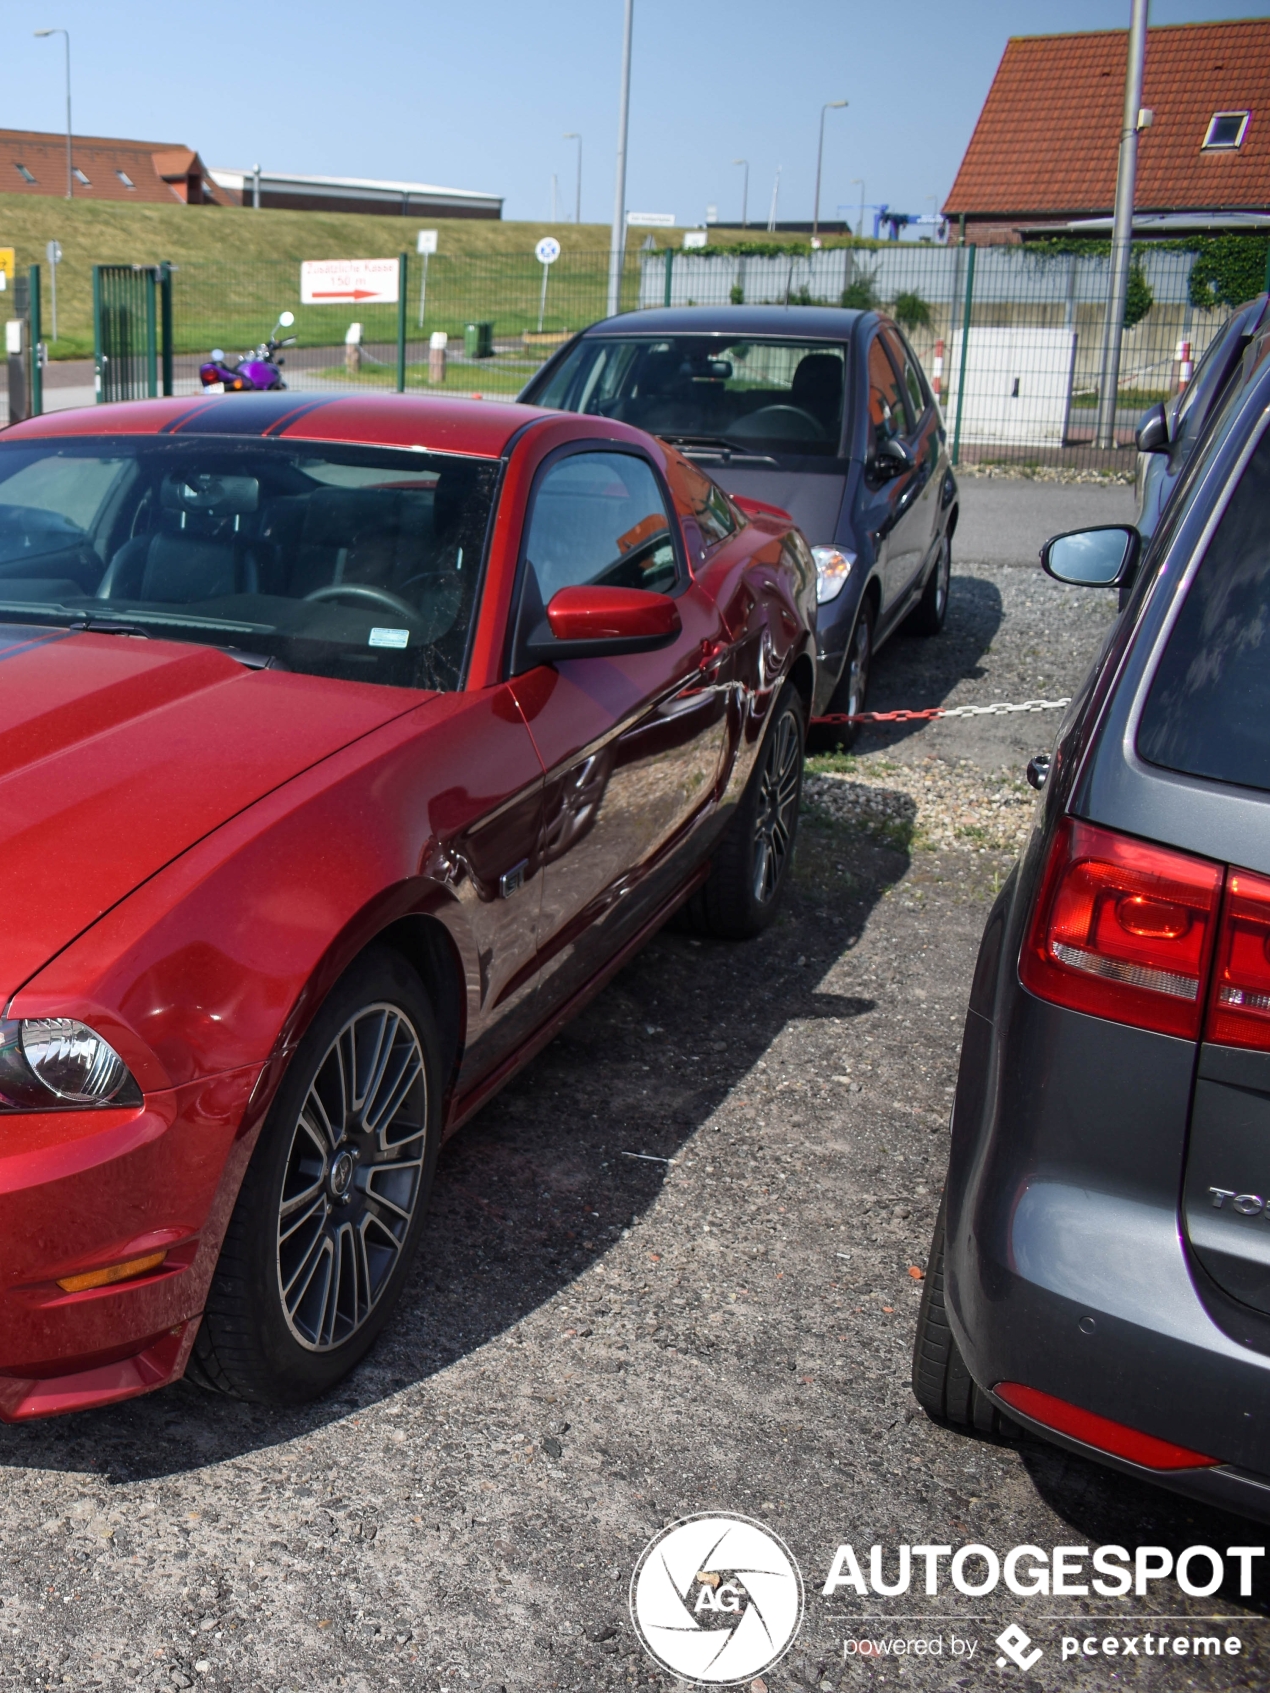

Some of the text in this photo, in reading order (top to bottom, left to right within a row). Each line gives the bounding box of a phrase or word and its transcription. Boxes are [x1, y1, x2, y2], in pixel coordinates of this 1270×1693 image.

[364, 260, 394, 273] Kasse
[330, 276, 366, 286] 150 m
[500, 858, 529, 899] GT
